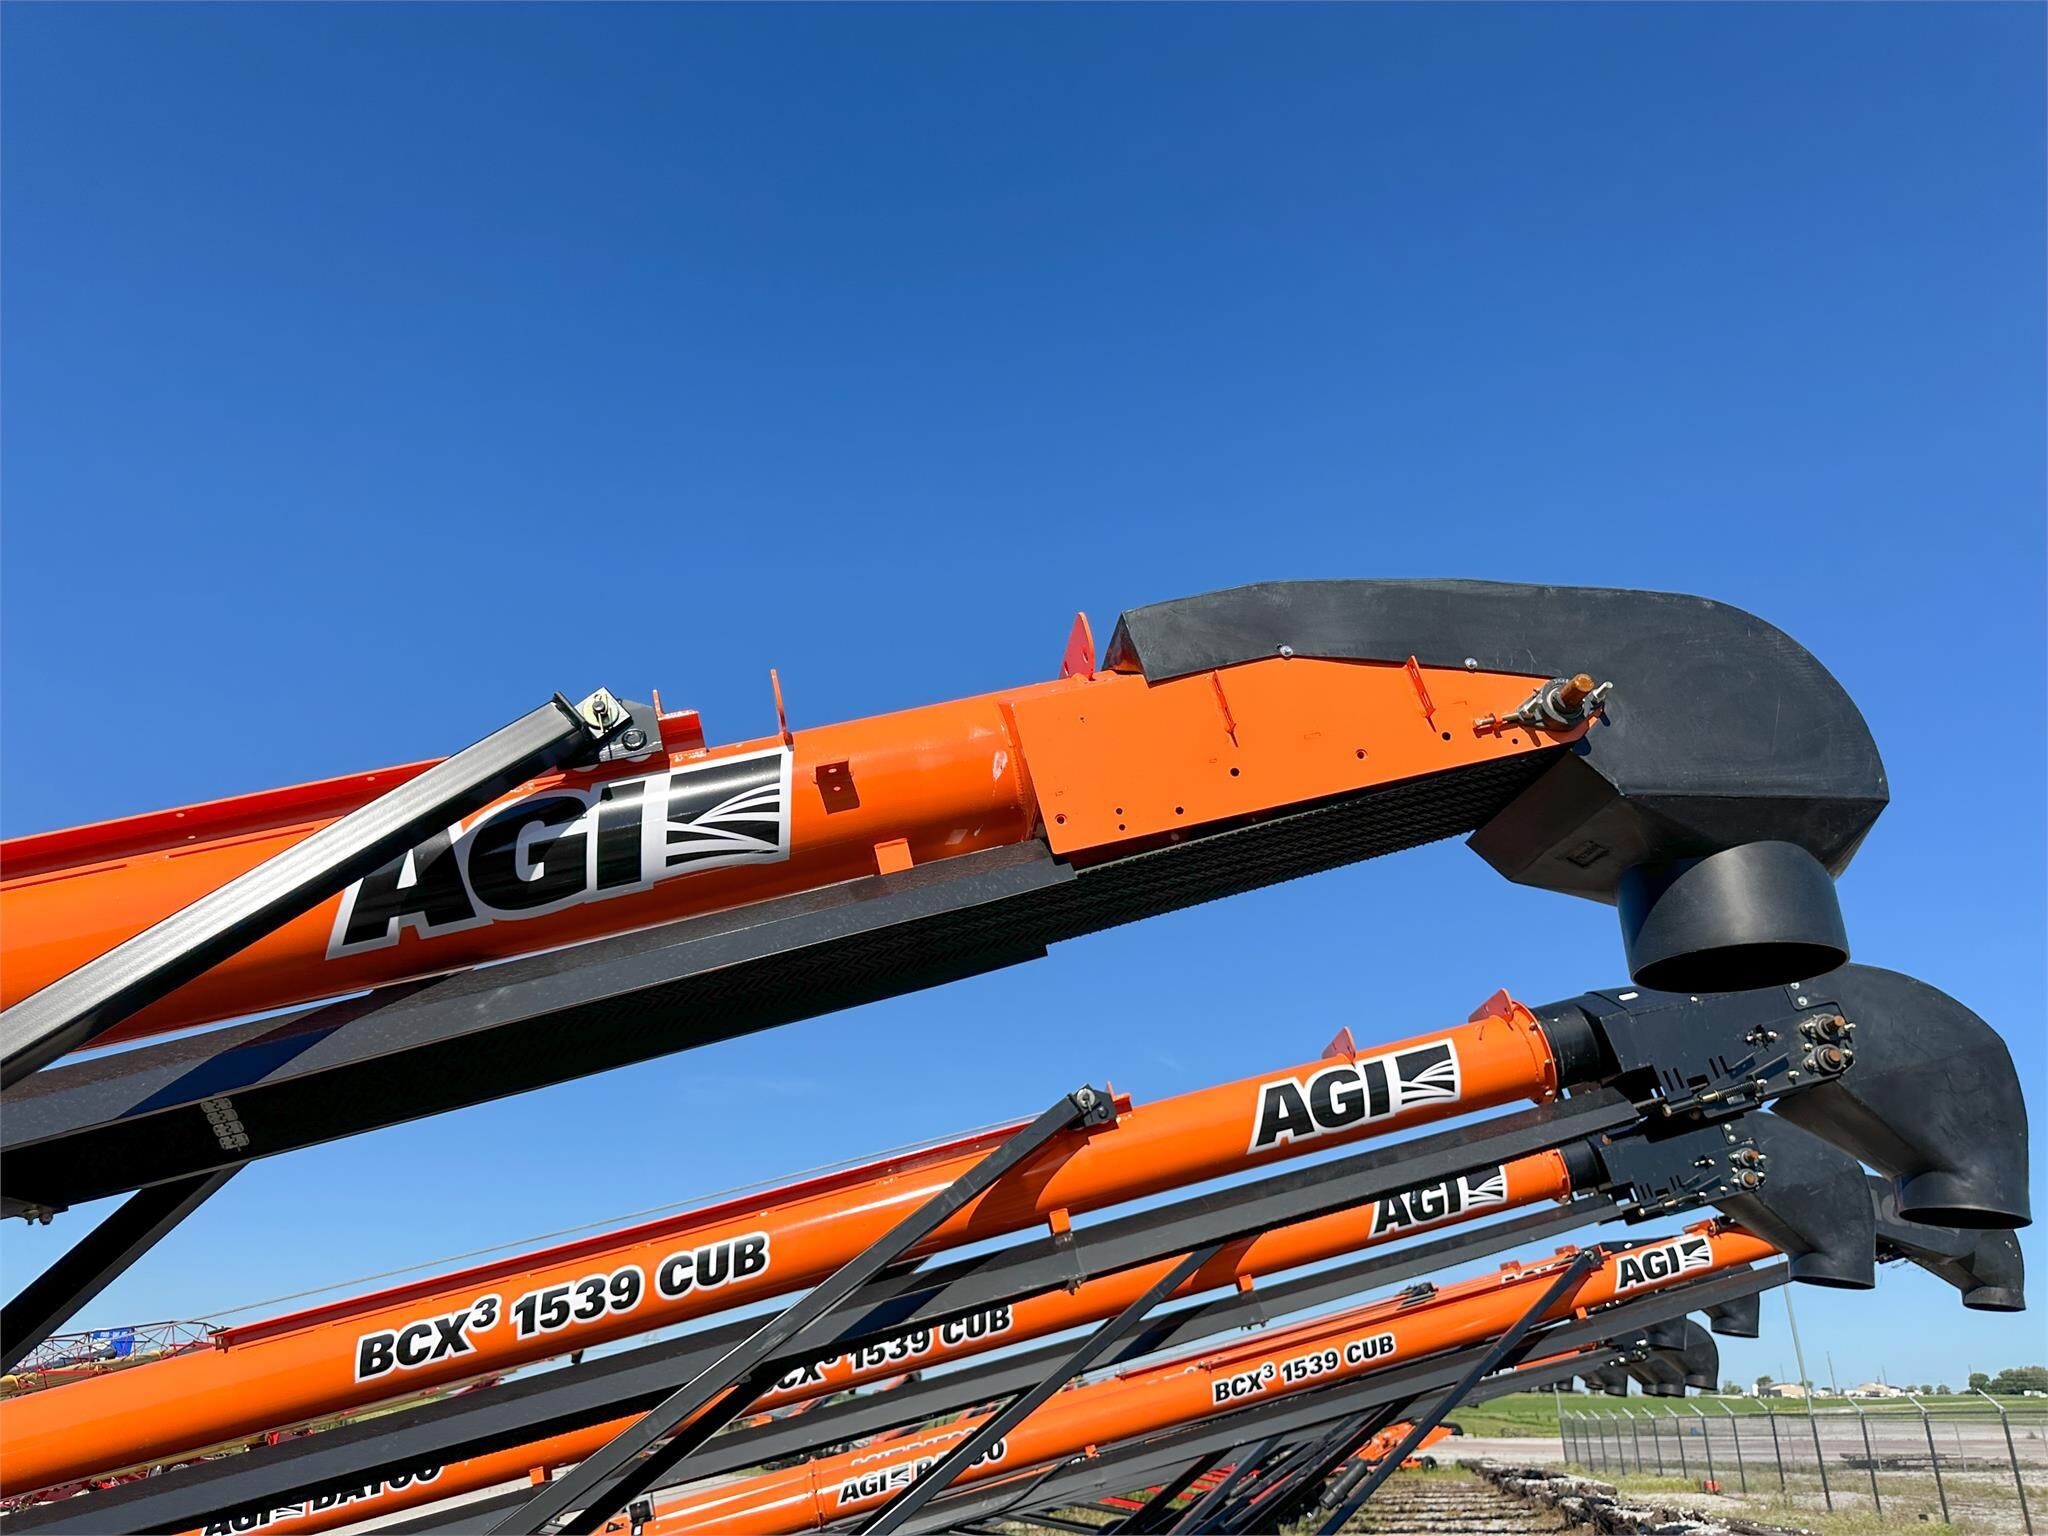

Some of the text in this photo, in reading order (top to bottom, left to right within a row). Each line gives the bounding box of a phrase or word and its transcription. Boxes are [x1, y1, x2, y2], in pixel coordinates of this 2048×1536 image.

[341, 777, 648, 947] AGI
[1255, 1059, 1391, 1148] AGI
[1373, 1177, 1462, 1234] AGI
[514, 1268, 642, 1336] 1539
[659, 1235, 767, 1296] CUB
[1618, 1246, 1681, 1289] AGI
[942, 1307, 1011, 1344] CUB
[1282, 1350, 1339, 1382] 1539
[1346, 1335, 1395, 1364] CUB
[840, 1474, 887, 1503] AGI
